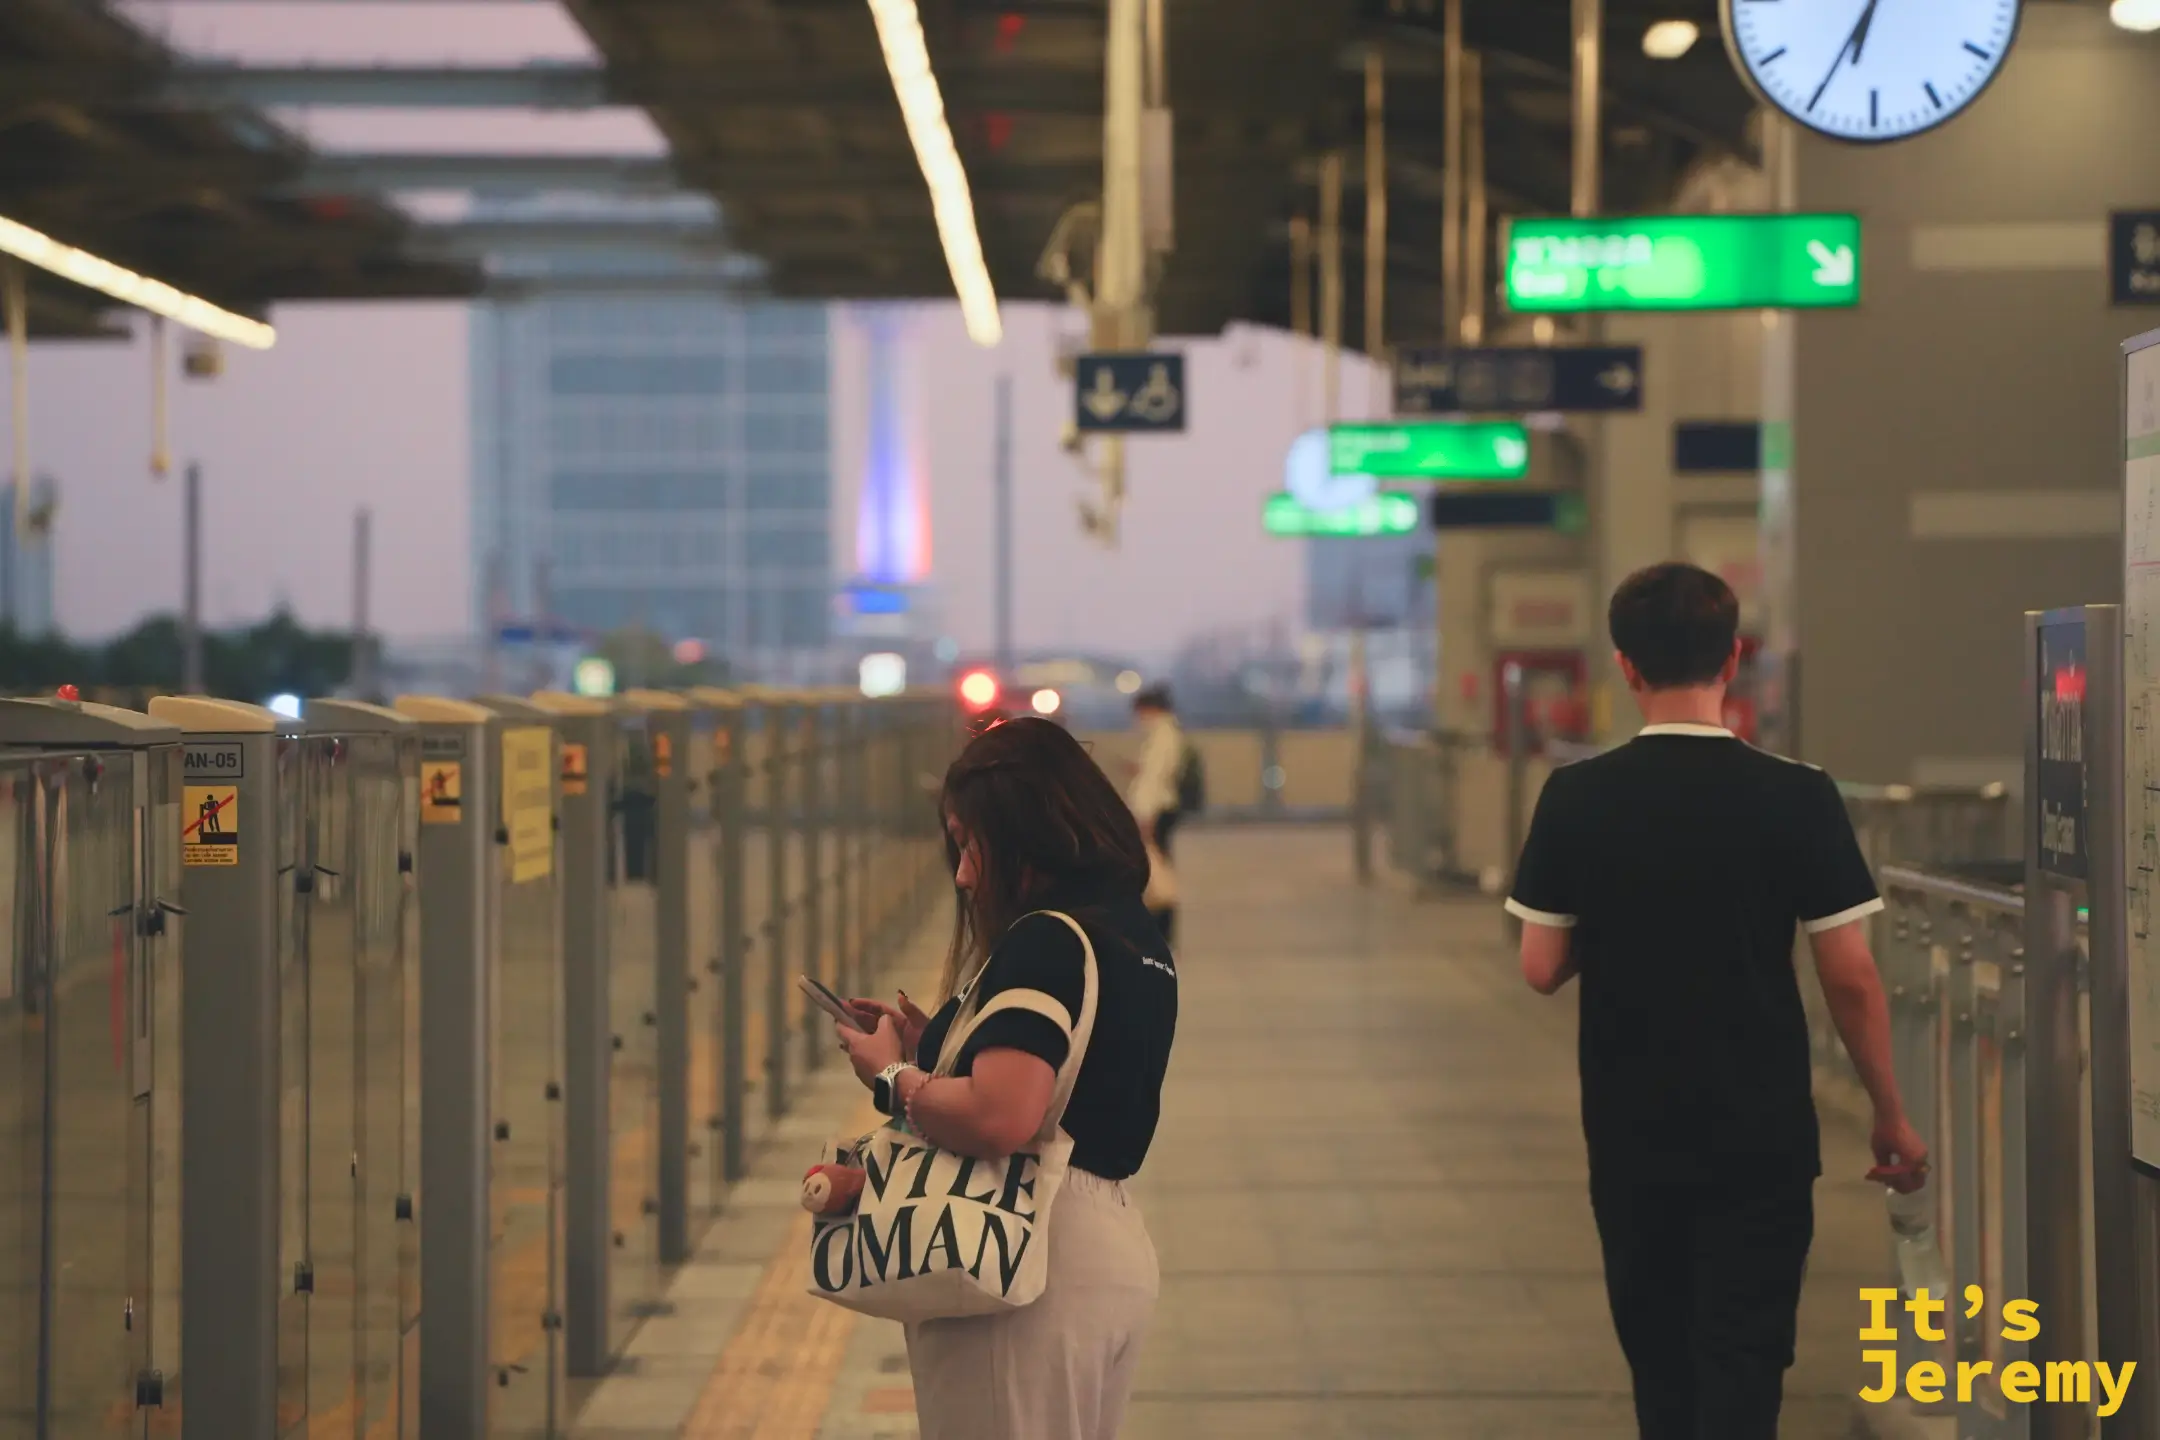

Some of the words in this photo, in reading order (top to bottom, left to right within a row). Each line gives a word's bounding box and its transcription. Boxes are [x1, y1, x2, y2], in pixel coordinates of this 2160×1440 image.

[184, 752, 237, 769] AN-05
[836, 1142, 1041, 1225] NTLE
[811, 1202, 1031, 1298] OMAN
